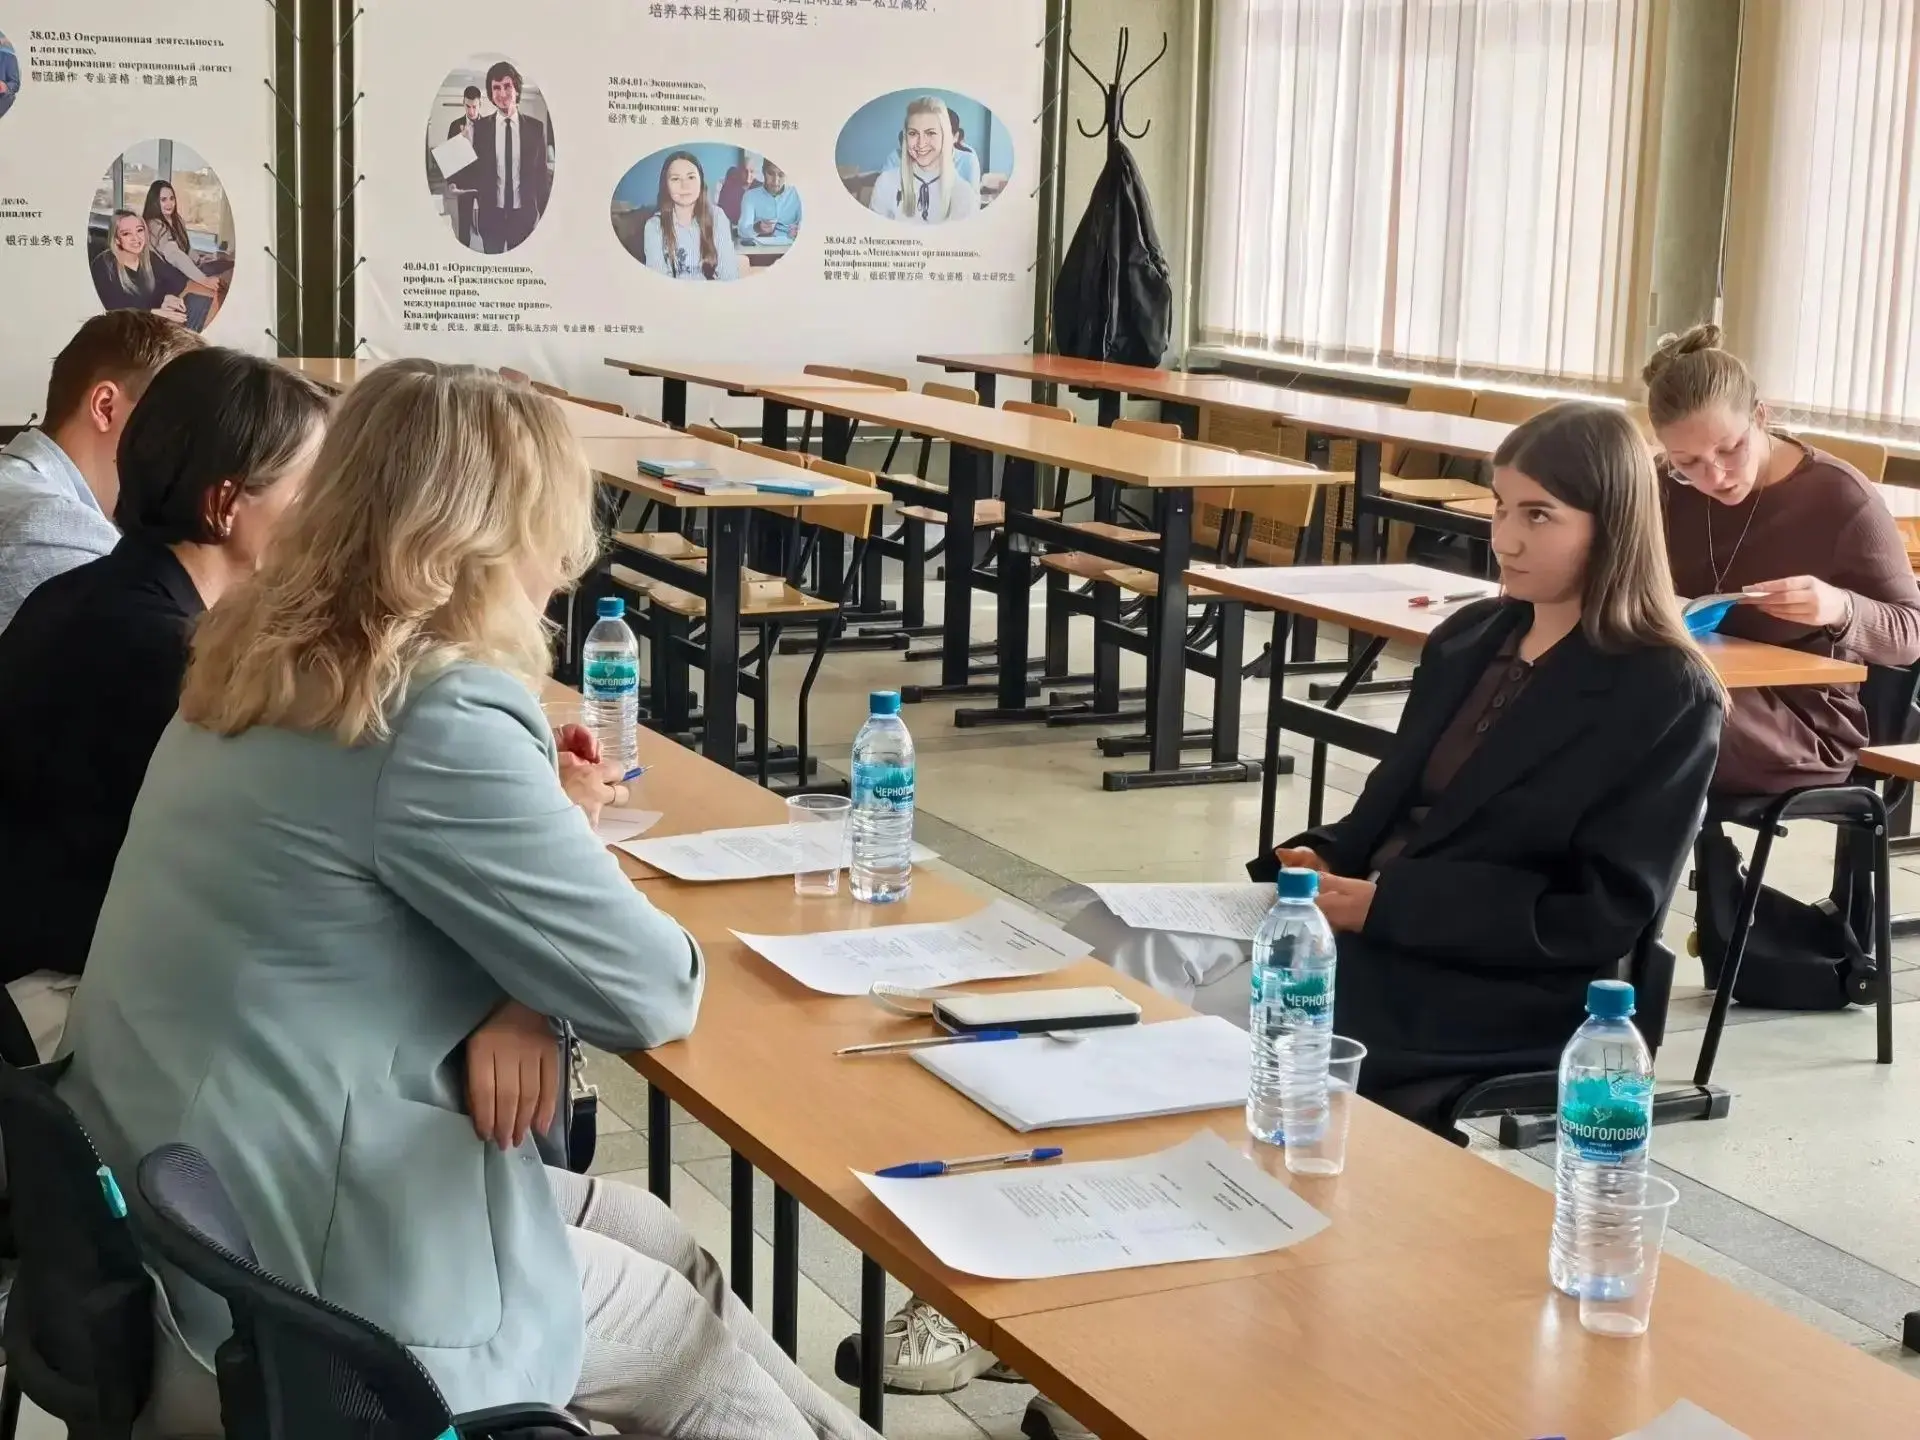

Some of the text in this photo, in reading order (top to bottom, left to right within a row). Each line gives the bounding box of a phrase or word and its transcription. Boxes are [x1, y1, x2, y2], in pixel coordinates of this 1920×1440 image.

[30, 30, 224, 47] 38.02.03 Операционная деятельность
[118, 61, 196, 72] операционный
[199, 64, 232, 72] логист
[32, 71, 77, 82] 物流操作
[608, 90, 648, 99] профиль
[683, 106, 719, 115] магистр
[5, 234, 74, 246] 银行业务专员
[824, 236, 857, 245] 38.04.02
[824, 248, 861, 258] профиль
[863, 247, 920, 257] «Менеджмент
[403, 262, 533, 274] 40.04.01 «Юриспруденция»,
[892, 262, 926, 270] магистр
[403, 275, 547, 287] профиль «Гражданское право,
[403, 287, 480, 297] семейное право,
[403, 300, 477, 309] международное
[479, 301, 516, 309] частное
[403, 310, 520, 322] Квалификация: магистр
